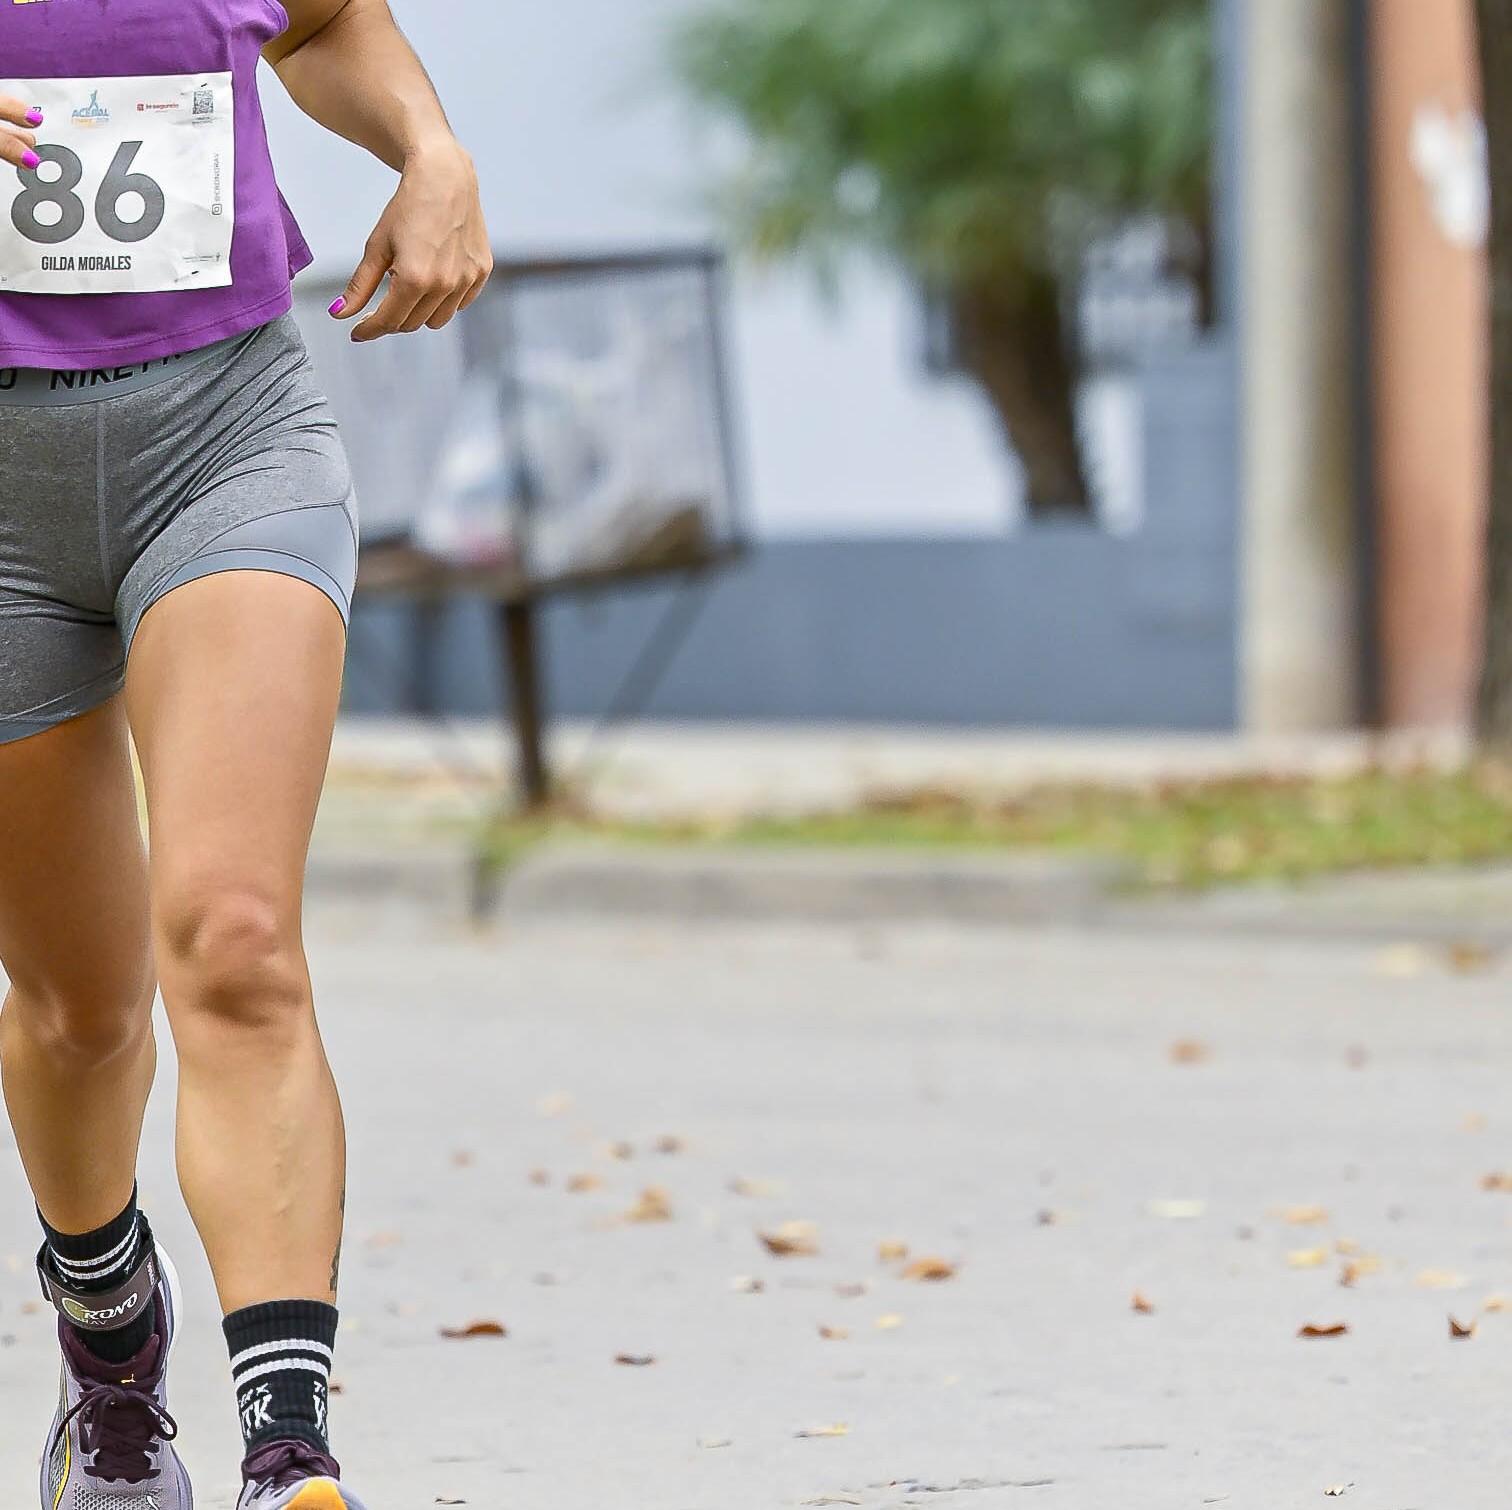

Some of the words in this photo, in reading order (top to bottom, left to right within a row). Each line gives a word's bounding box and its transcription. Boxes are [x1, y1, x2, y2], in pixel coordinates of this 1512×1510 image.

[11, 140, 165, 244] 86
[41, 256, 75, 271] GILDA
[78, 255, 132, 271] MORALES
[50, 364, 134, 390] NIKE
